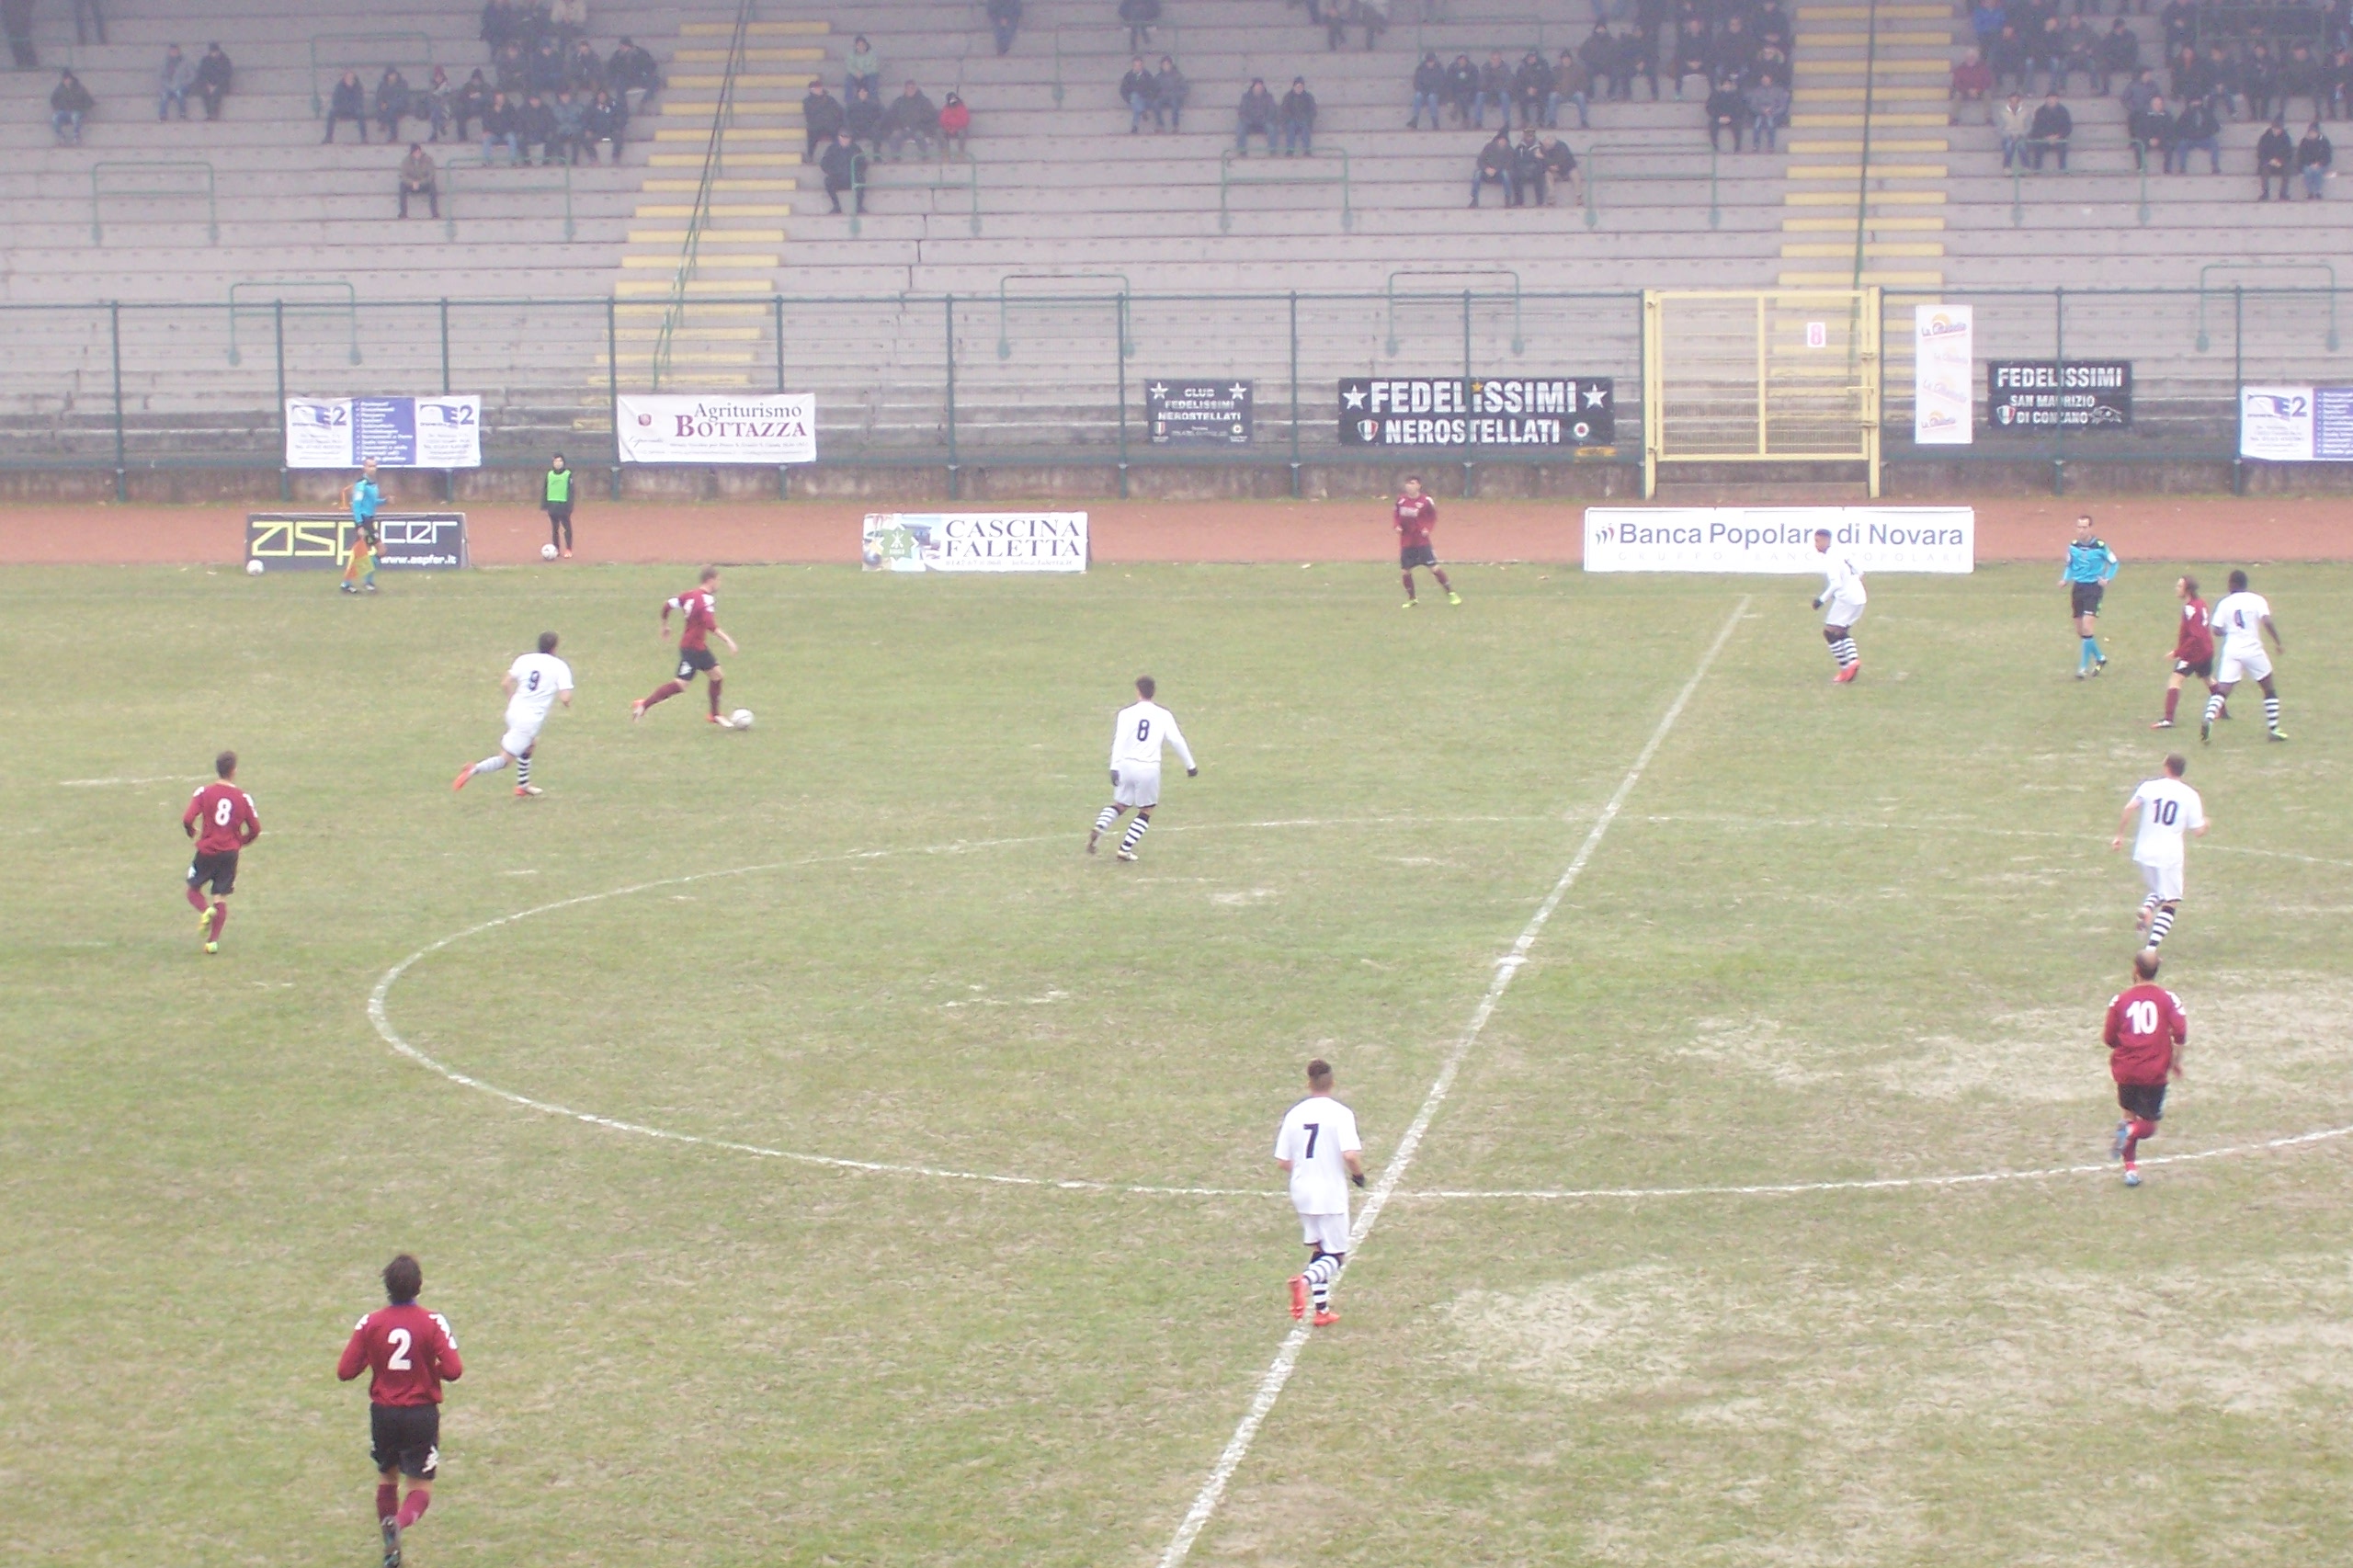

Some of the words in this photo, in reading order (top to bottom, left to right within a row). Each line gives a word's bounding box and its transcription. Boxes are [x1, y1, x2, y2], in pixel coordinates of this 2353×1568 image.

[1997, 368, 2122, 387] FEDELISSIMI
[1165, 400, 1234, 409] FEDELISSIMI
[2010, 395, 2034, 407] SAN
[694, 403, 802, 422] Agriturismo
[1158, 412, 1241, 421] NEROSTELLATI
[2017, 412, 2029, 424] DI
[674, 415, 807, 437] BOTTAZZA
[1385, 418, 1561, 444] NEROSTELLATI
[946, 519, 1081, 538] CASCINA
[1620, 523, 1701, 544] Banca
[1710, 523, 1825, 550] Popolar
[1837, 523, 1860, 544] di
[1869, 523, 1963, 545] Novara
[946, 540, 1081, 557] FALETTA
[1755, 551, 1827, 562] BANC
[528, 670, 540, 691] 9
[1137, 719, 1151, 743] 8
[214, 797, 233, 826] 8
[2153, 797, 2179, 826] 10
[2126, 1000, 2159, 1035] 10
[1303, 1123, 1320, 1159] 7
[387, 1328, 412, 1370] 2
